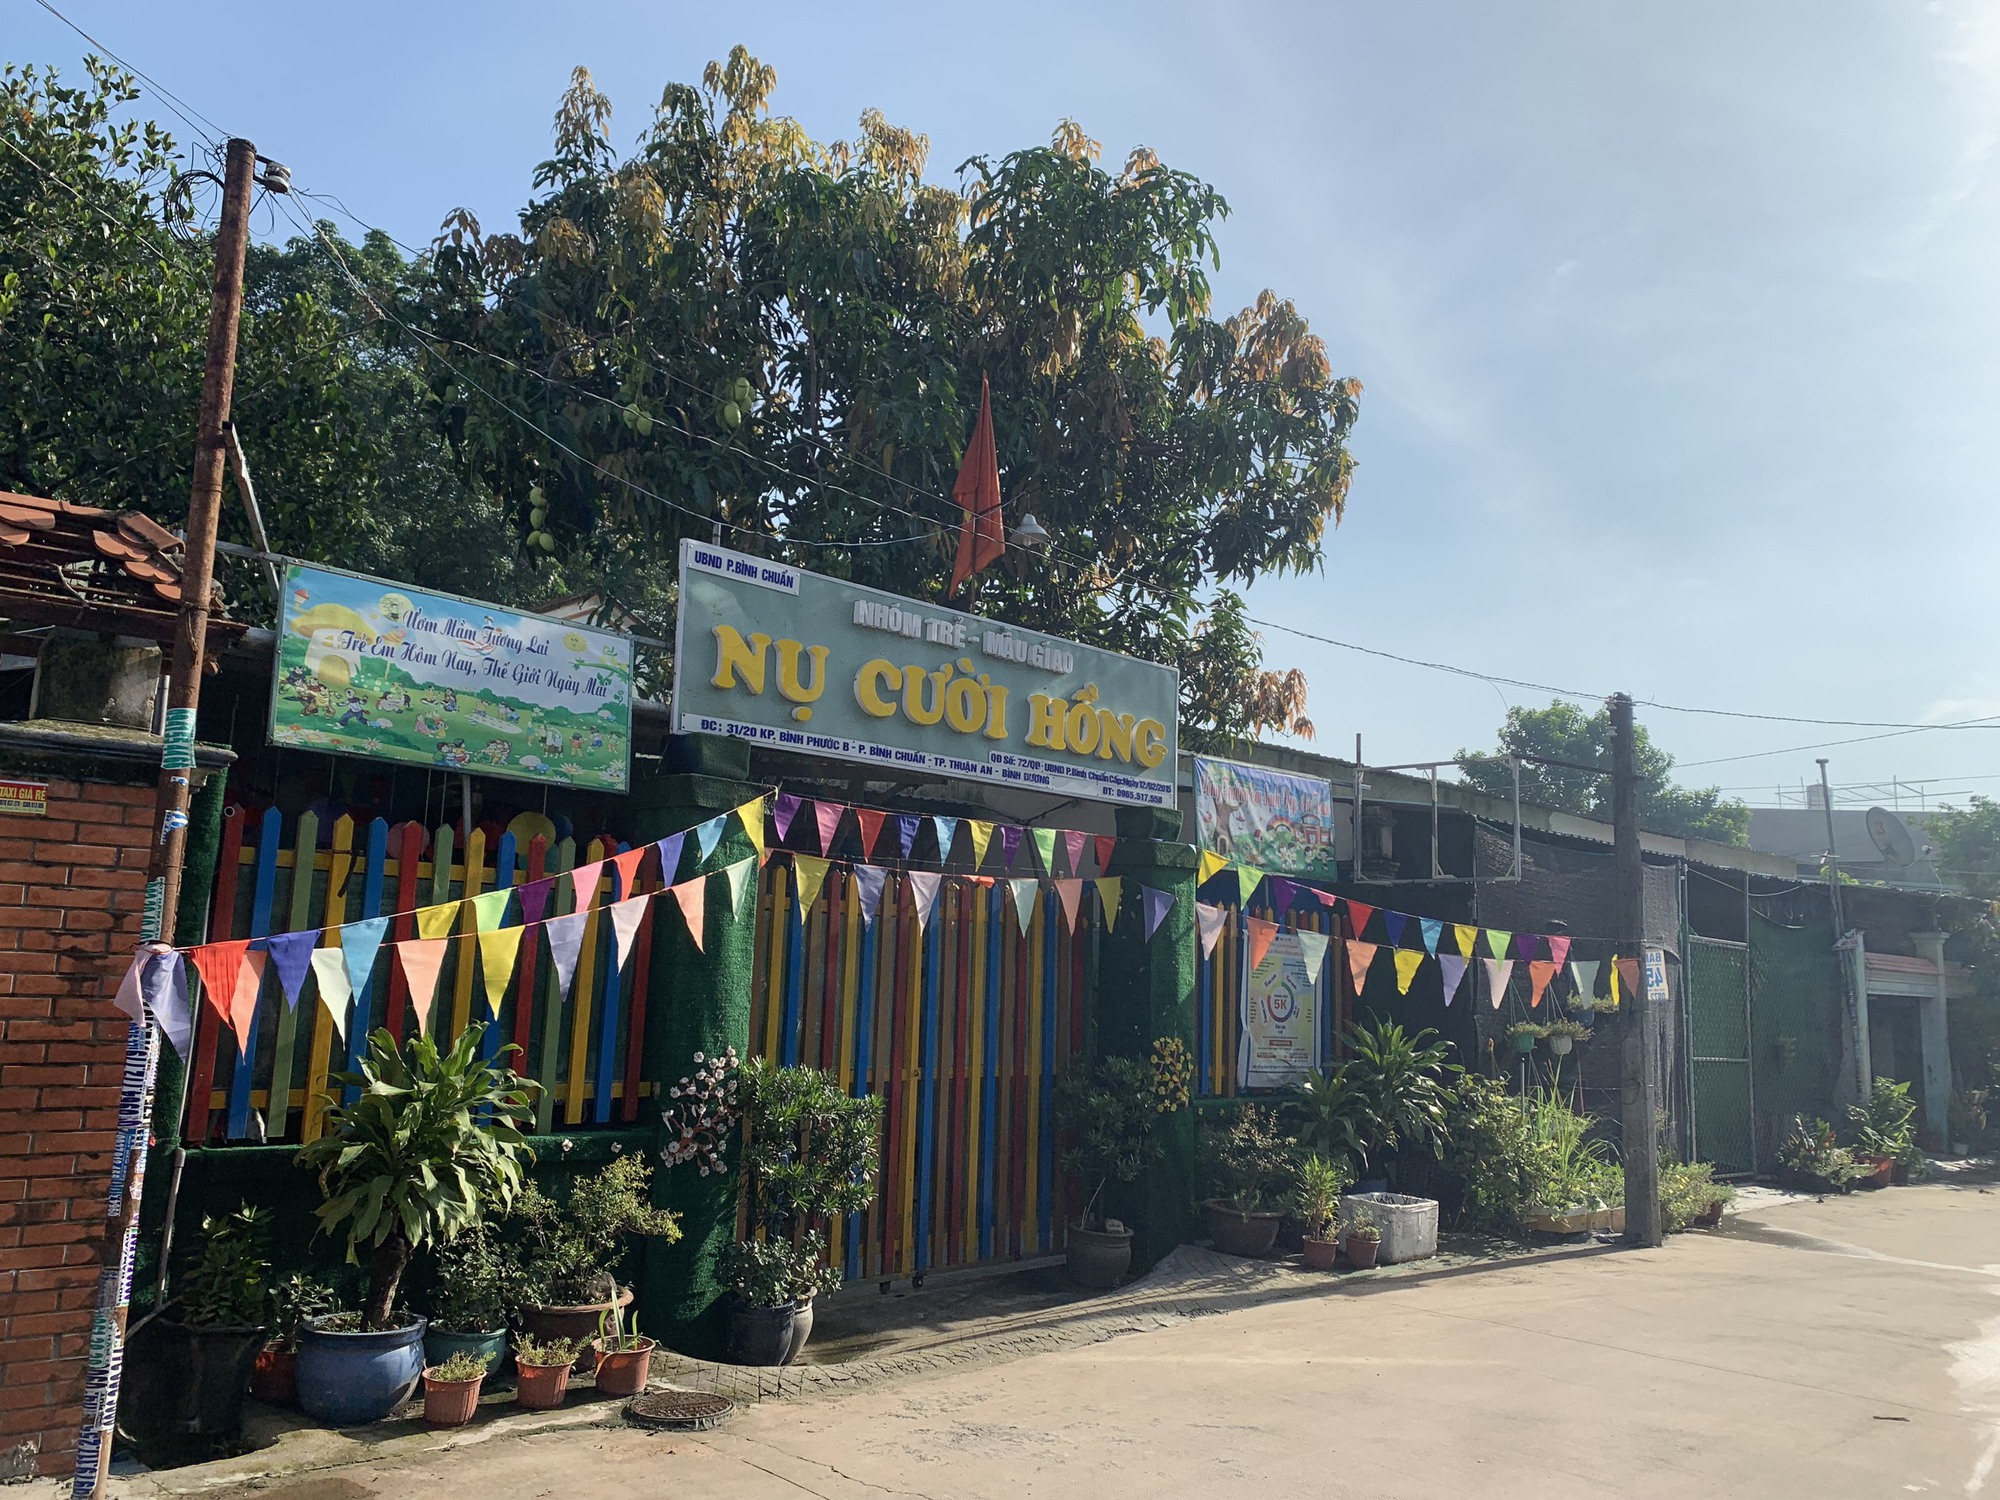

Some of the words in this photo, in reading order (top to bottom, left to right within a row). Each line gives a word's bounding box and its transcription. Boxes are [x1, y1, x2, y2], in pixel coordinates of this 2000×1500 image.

[694, 550, 722, 569] UBND
[726, 558, 758, 579] P.BÌNH
[402, 607, 437, 633] Ươm
[440, 618, 476, 641] Mầm
[480, 626, 523, 654] Tương
[526, 635, 550, 656] Lai
[852, 600, 922, 639] NHÓM
[924, 616, 966, 648] TRẺ
[340, 630, 367, 653] Trẻ
[371, 638, 394, 658] Em
[400, 642, 436, 666] Hôm
[441, 650, 477, 676] Nay,
[482, 657, 510, 679] Thế
[510, 664, 540, 686] Giới
[544, 668, 586, 696] Ngày
[585, 676, 608, 698] Mai
[710, 624, 830, 722] NỤ
[854, 657, 1009, 739] CƯỜI
[1024, 683, 1168, 768] HỒNG
[726, 724, 756, 737] 31/20
[760, 728, 776, 740] KP.
[780, 730, 804, 744] BÌNH
[806, 736, 840, 750] PHƯỚC
[842, 742, 850, 752] B
[858, 744, 866, 755] P.
[870, 744, 892, 759] BÌNH
[934, 757, 947, 768] TP.
[950, 760, 977, 774] THUẬN
[980, 766, 992, 776] AN
[1002, 767, 1021, 780] BÌNH
[1024, 772, 1050, 785] DƯƠNG
[990, 753, 1002, 764] QĐ
[1003, 756, 1016, 766] Số:
[1044, 763, 1064, 774] UBND
[1102, 786, 1114, 796] ĐT:
[1274, 999, 1286, 1010] 5K
